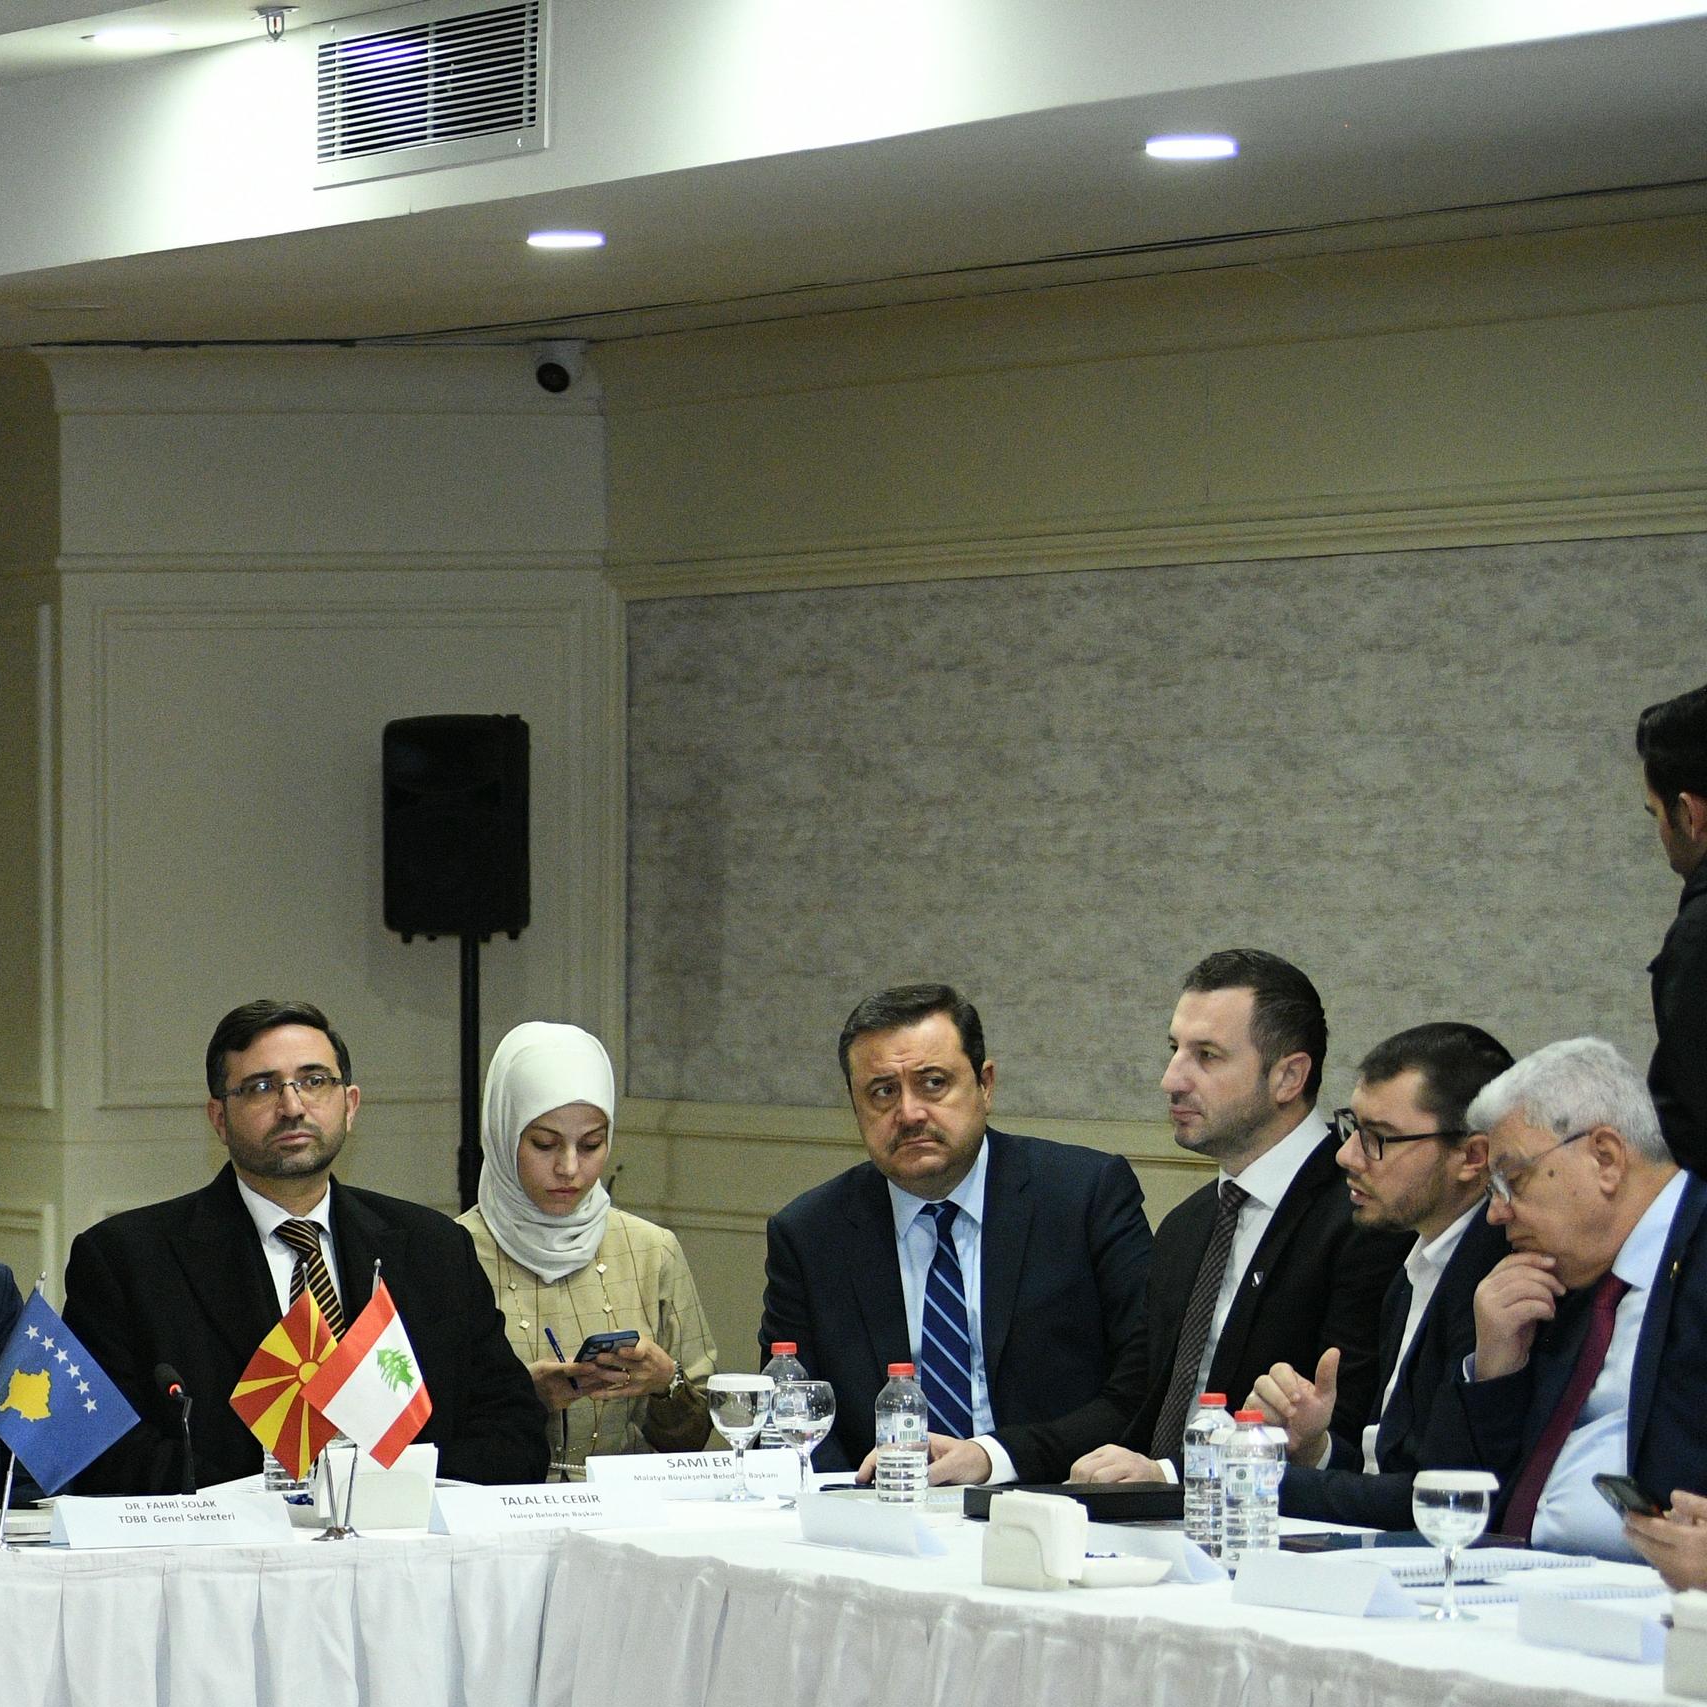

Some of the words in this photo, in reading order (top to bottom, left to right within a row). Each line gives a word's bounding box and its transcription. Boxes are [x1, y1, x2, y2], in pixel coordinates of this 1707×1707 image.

[667, 1456, 708, 1468] SAMİ
[713, 1457, 732, 1467] ER
[125, 1502, 144, 1510] DR.
[147, 1500, 179, 1510] FAHRİ
[182, 1500, 217, 1509] SOLAK
[499, 1496, 541, 1506] TALAL
[544, 1495, 560, 1504] EL
[562, 1493, 601, 1504] CEBİR
[118, 1515, 147, 1524] TDBB
[153, 1514, 185, 1523] Genel
[187, 1511, 236, 1521] Sekreteri
